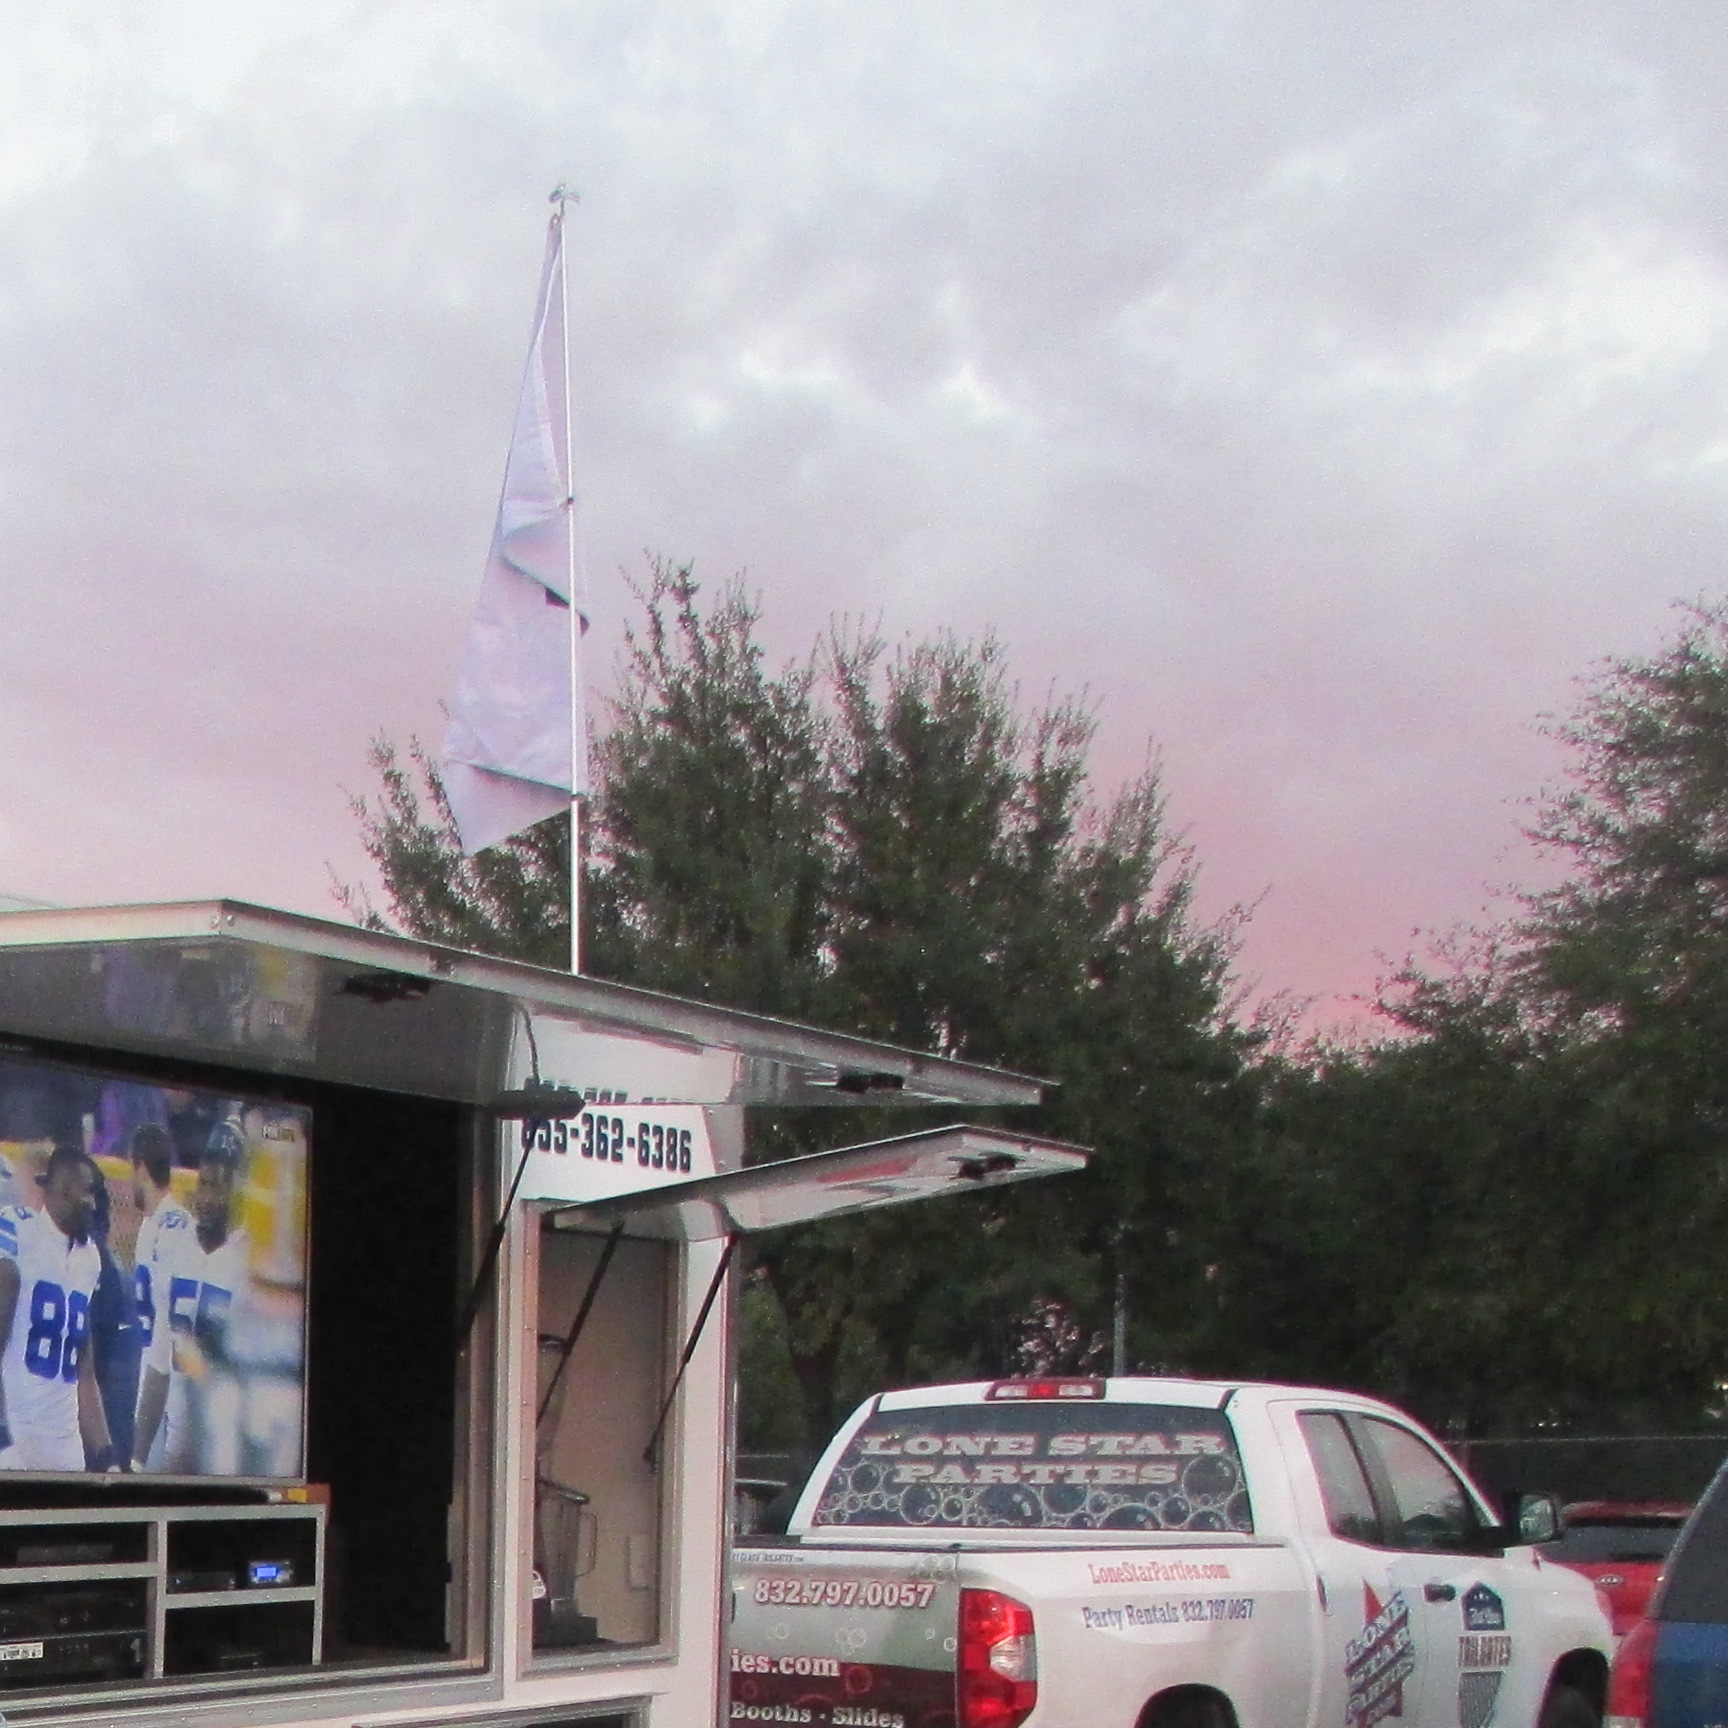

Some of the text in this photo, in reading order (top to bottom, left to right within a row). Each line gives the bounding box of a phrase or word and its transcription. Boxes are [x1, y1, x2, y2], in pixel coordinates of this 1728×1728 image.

[860, 1433, 1227, 1456] LONE STAR
[893, 1463, 1177, 1486] PARTIES
[1088, 1560, 1230, 1584] LoneStarParties.com
[755, 1579, 935, 1608] 832.797.0057
[1082, 1606, 1123, 1631] Party
[1124, 1602, 1179, 1626] Rentals
[731, 1700, 811, 1723] Booths
